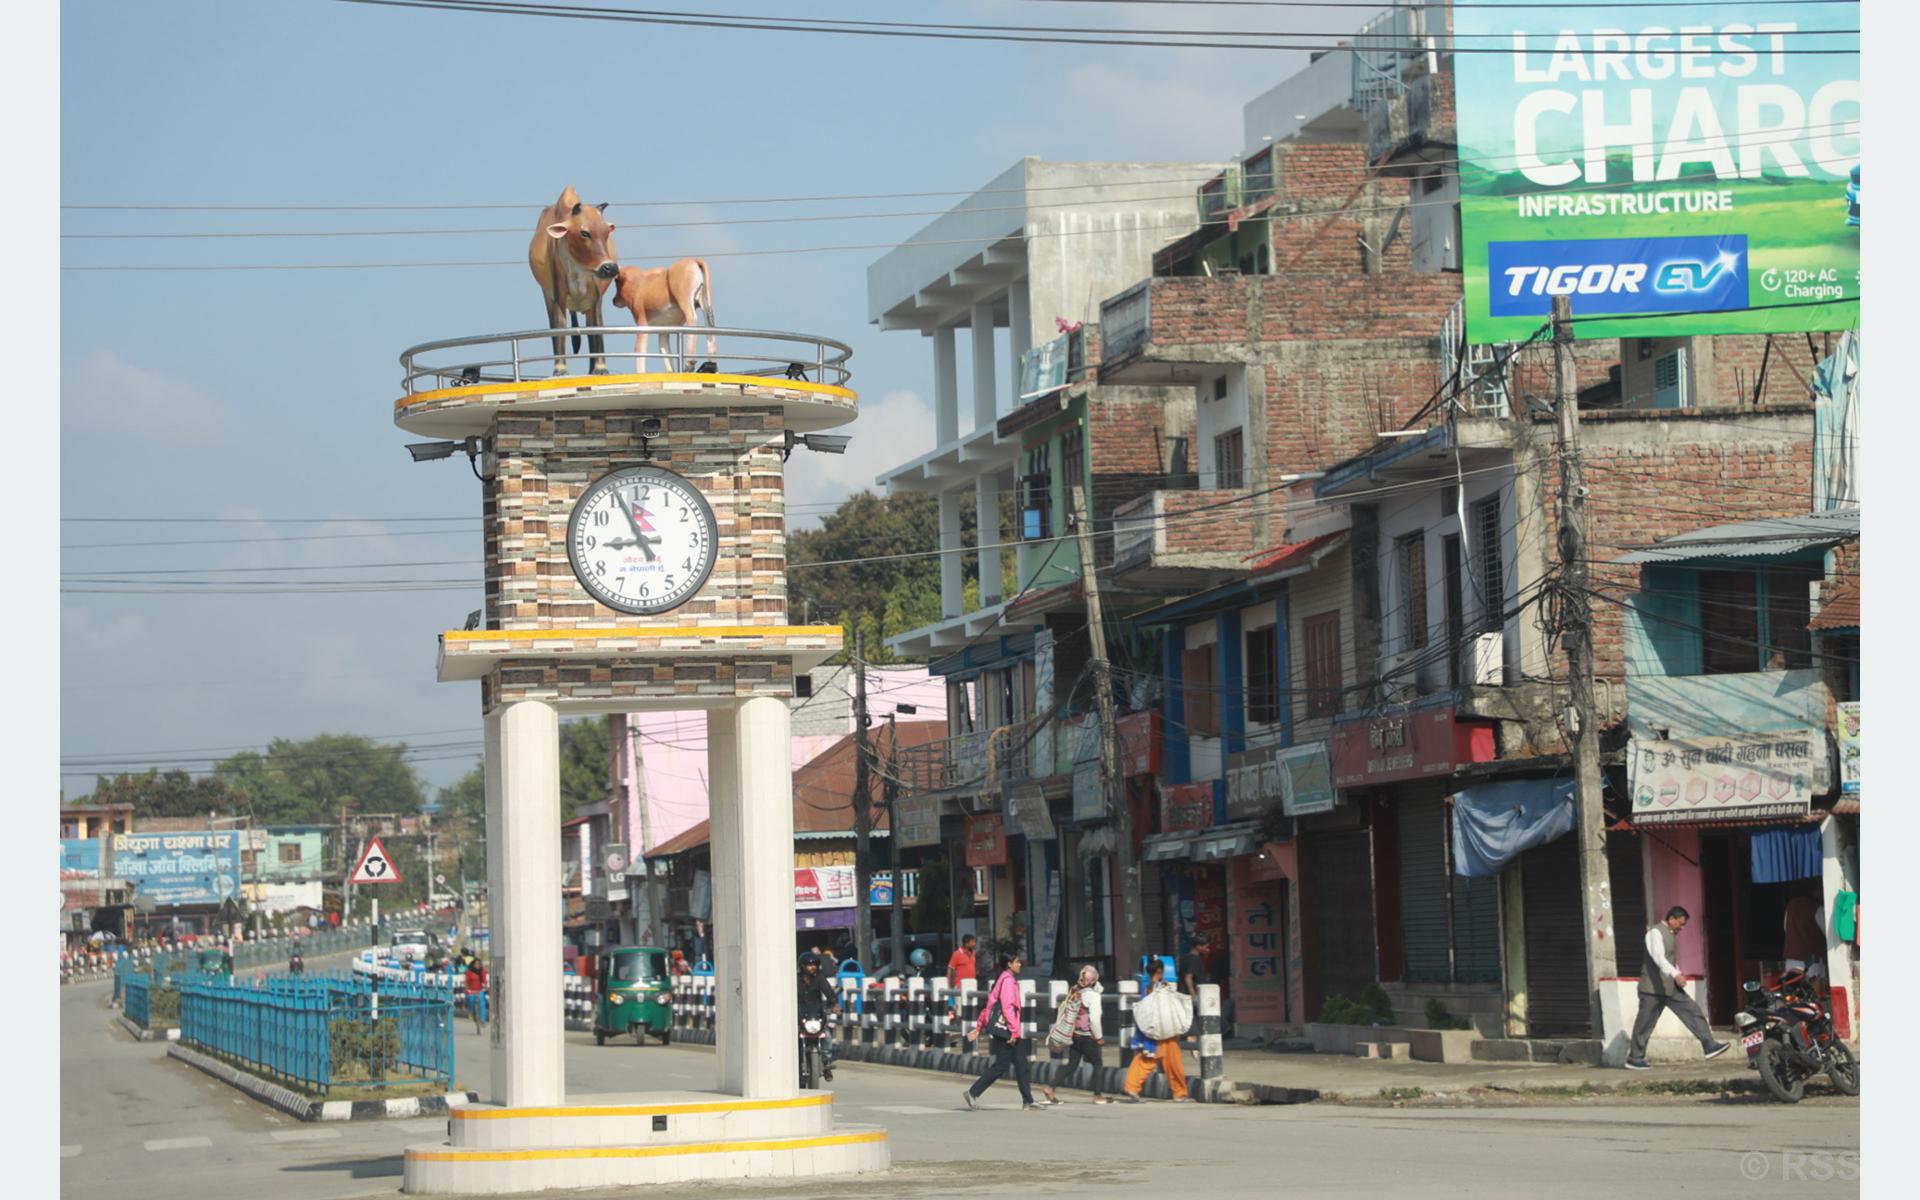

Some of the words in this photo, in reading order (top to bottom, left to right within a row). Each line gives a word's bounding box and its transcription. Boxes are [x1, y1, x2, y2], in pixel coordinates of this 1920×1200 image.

[1513, 22, 1797, 83] LARGEST
[1519, 191, 1733, 218] INFRASTRUCTURE
[1504, 263, 1648, 296] TIGOR
[1654, 262, 1724, 293] EV
[1784, 269, 1815, 283] 120+
[1818, 268, 1837, 282] AC
[1784, 283, 1843, 299] Charging
[633, 485, 650, 500] 12
[664, 492, 669, 507] 1
[594, 510, 609, 526] 10
[680, 507, 688, 522] 2
[586, 536, 596, 551] 9
[689, 532, 699, 548] 3
[596, 560, 606, 576] 8
[682, 556, 692, 572] 4
[616, 577, 625, 592] 7
[640, 581, 649, 597] 6
[665, 574, 675, 590] 5
[610, 872, 625, 883] LG
